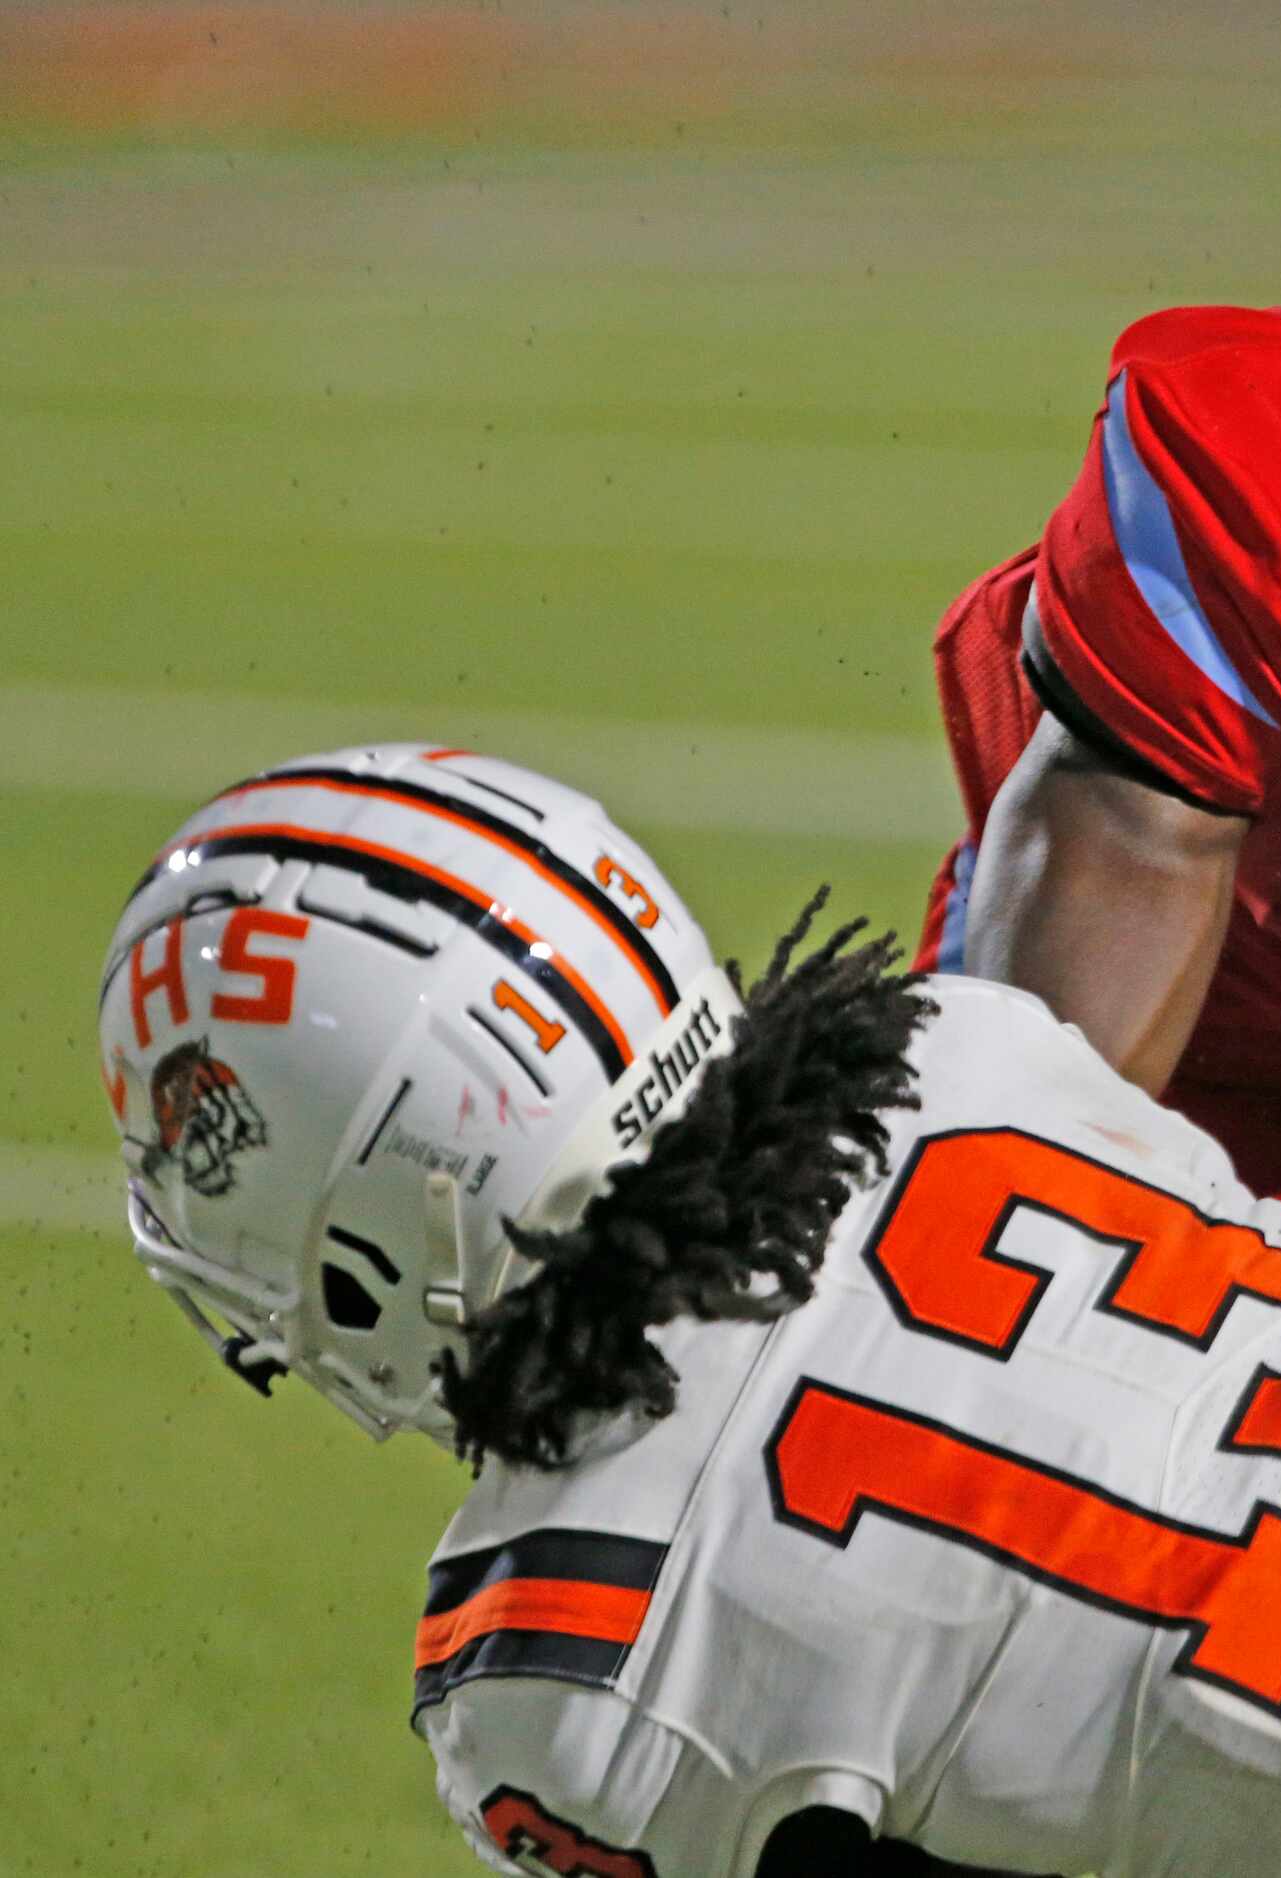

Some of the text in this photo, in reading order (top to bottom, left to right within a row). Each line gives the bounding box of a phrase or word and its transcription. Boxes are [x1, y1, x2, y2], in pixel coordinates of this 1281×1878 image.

[491, 855, 660, 1054] 1 3
[611, 997, 721, 1149] schutt
